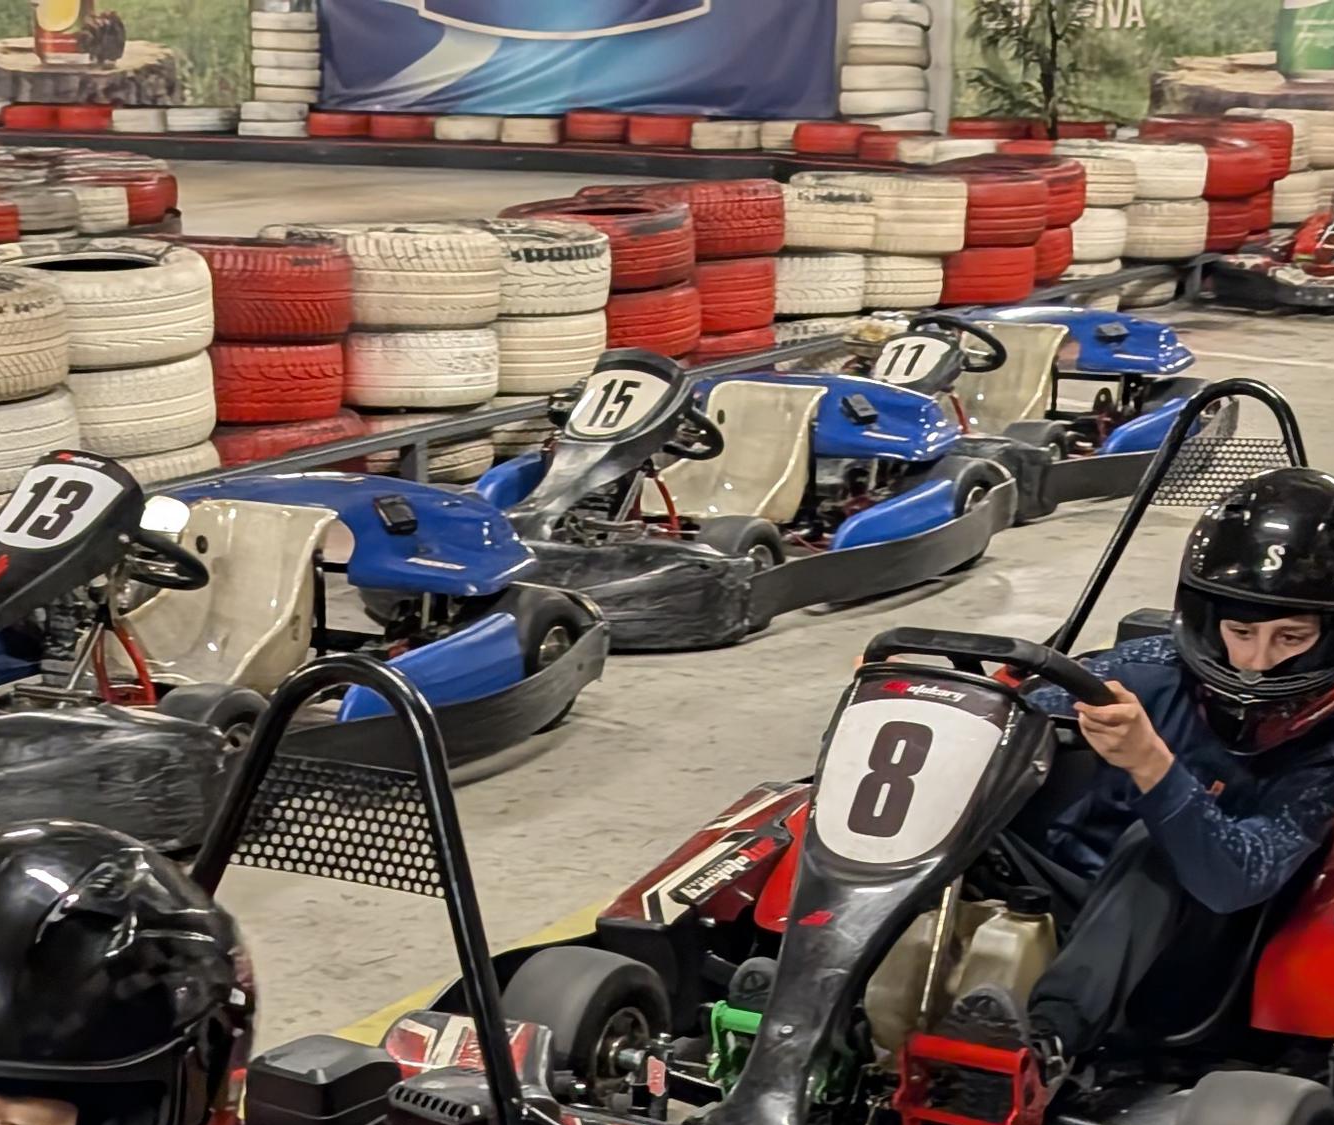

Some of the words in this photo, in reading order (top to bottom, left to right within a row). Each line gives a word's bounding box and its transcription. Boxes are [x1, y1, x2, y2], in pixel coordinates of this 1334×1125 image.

[884, 344, 926, 376] 11
[587, 379, 642, 428] 15
[4, 476, 94, 540] 13
[1261, 545, 1286, 573] S
[847, 721, 933, 838] 8
